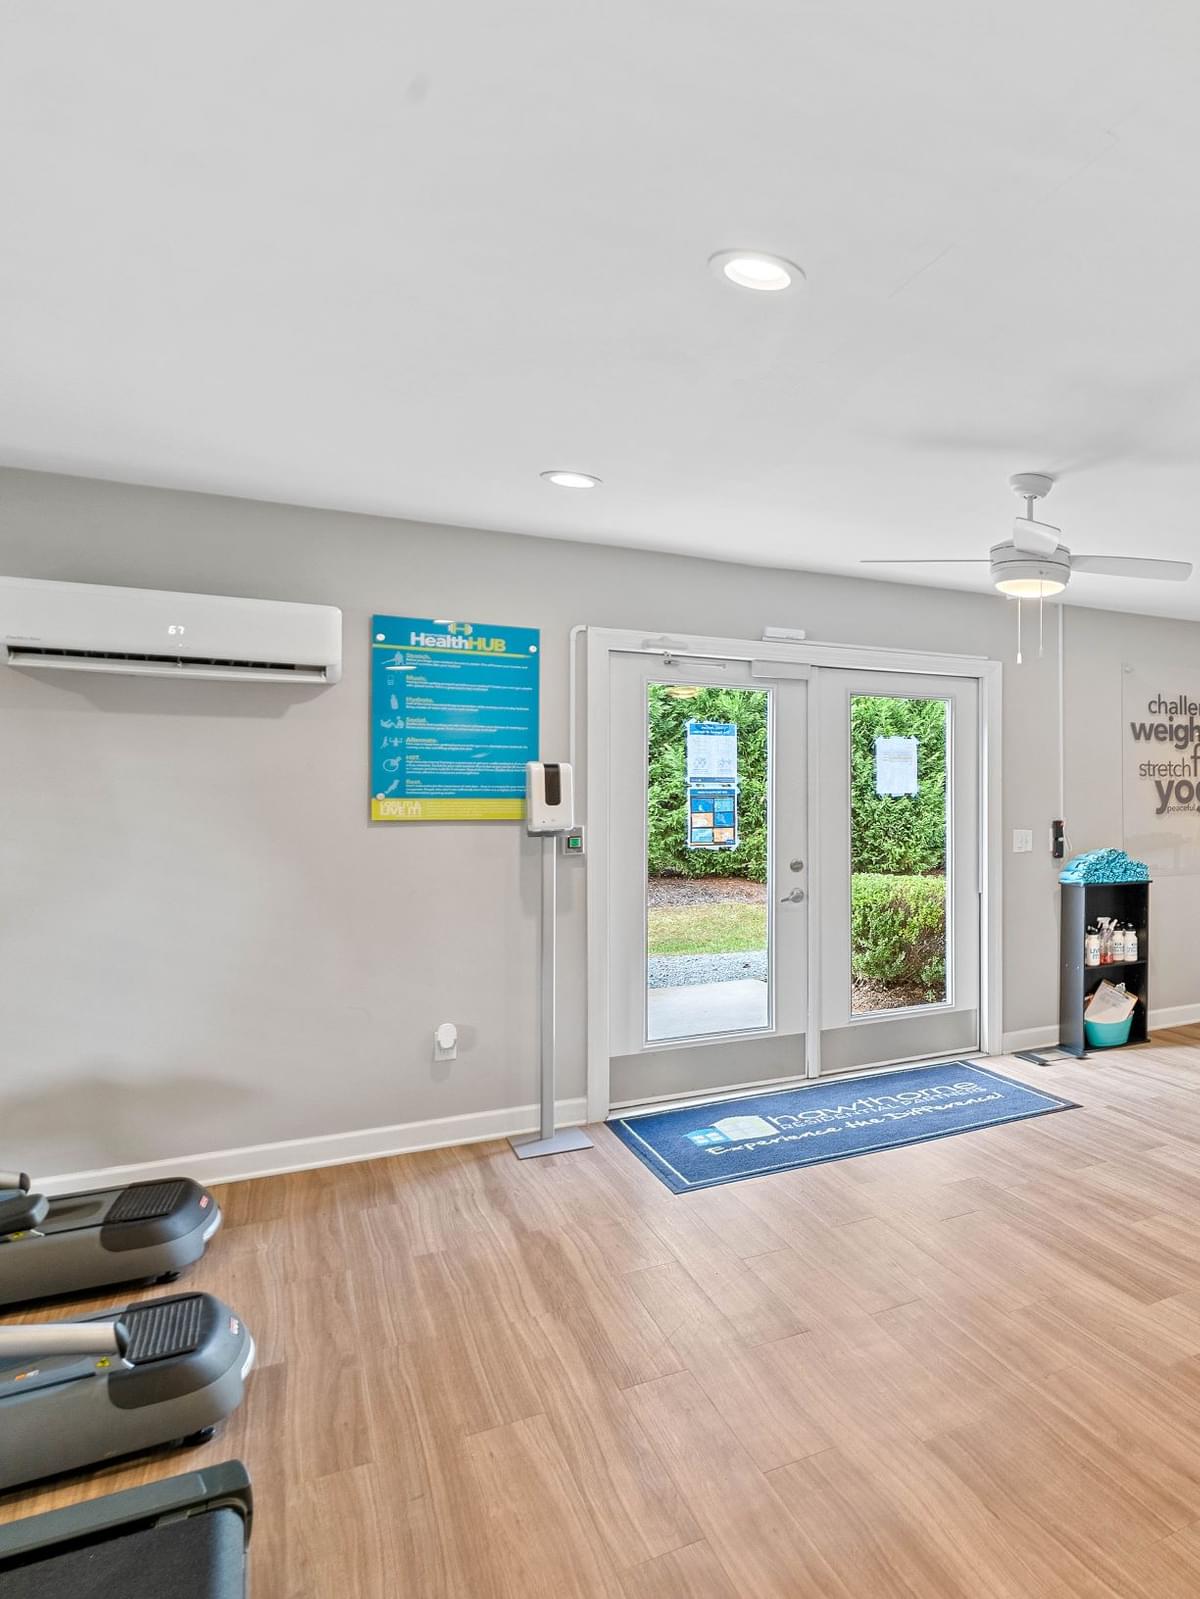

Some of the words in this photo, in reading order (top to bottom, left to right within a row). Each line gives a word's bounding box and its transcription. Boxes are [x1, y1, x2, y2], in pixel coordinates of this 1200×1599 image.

[410, 631, 506, 652] HealthHUB
[1139, 756, 1191, 778] stretch
[1166, 803, 1197, 814] peaceful
[767, 1081, 979, 1125] hawthorne
[779, 1103, 900, 1131] RESIDENTIAL
[901, 1087, 988, 1106] PARTNERS
[705, 1126, 843, 1155] Experience
[845, 1116, 886, 1130] the
